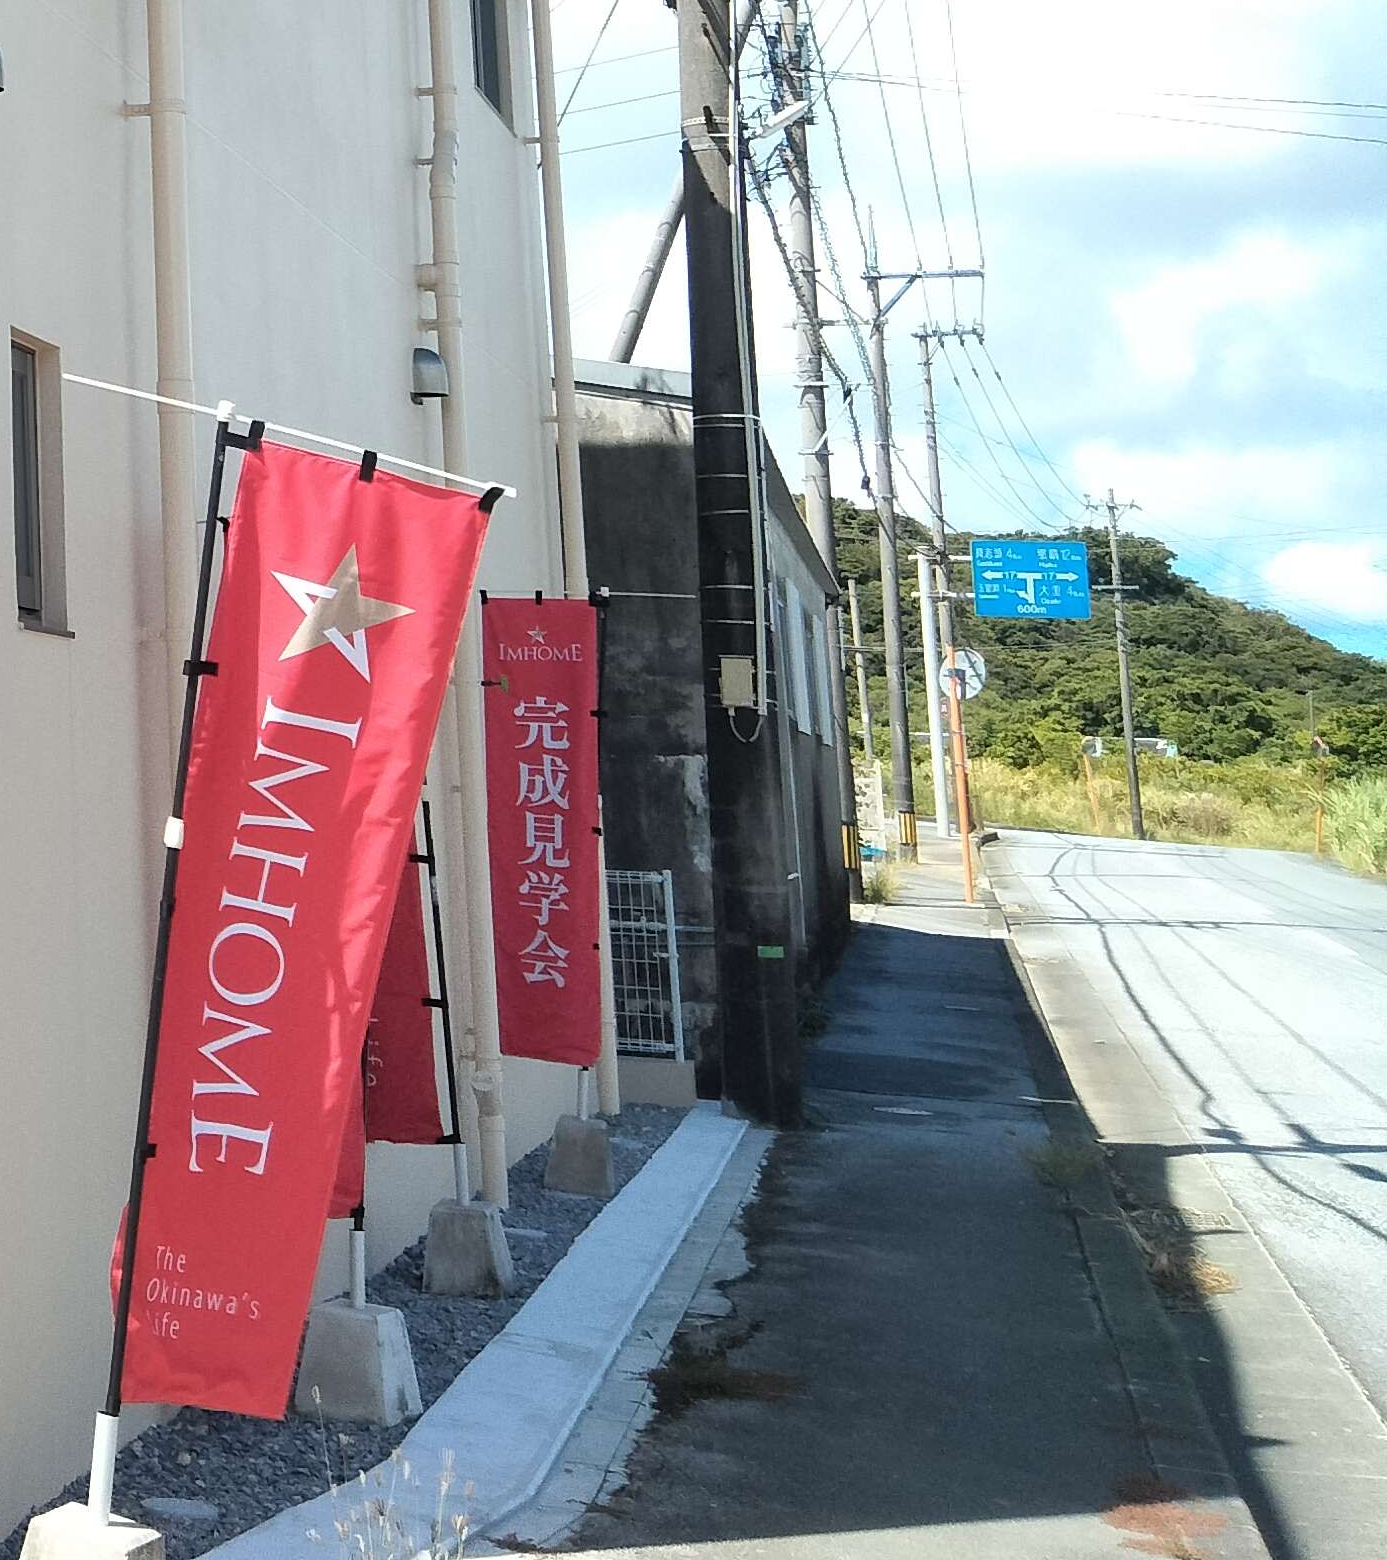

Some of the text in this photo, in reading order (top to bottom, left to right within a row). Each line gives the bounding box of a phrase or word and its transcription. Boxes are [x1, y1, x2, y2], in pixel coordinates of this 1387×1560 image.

[1017, 604, 1046, 614] 600m
[499, 643, 582, 661] IMHOME
[514, 696, 570, 988] 完成見学会
[188, 695, 363, 1176] IMHOME
[156, 1245, 187, 1273] The
[146, 1278, 260, 1320] Okinawa's
